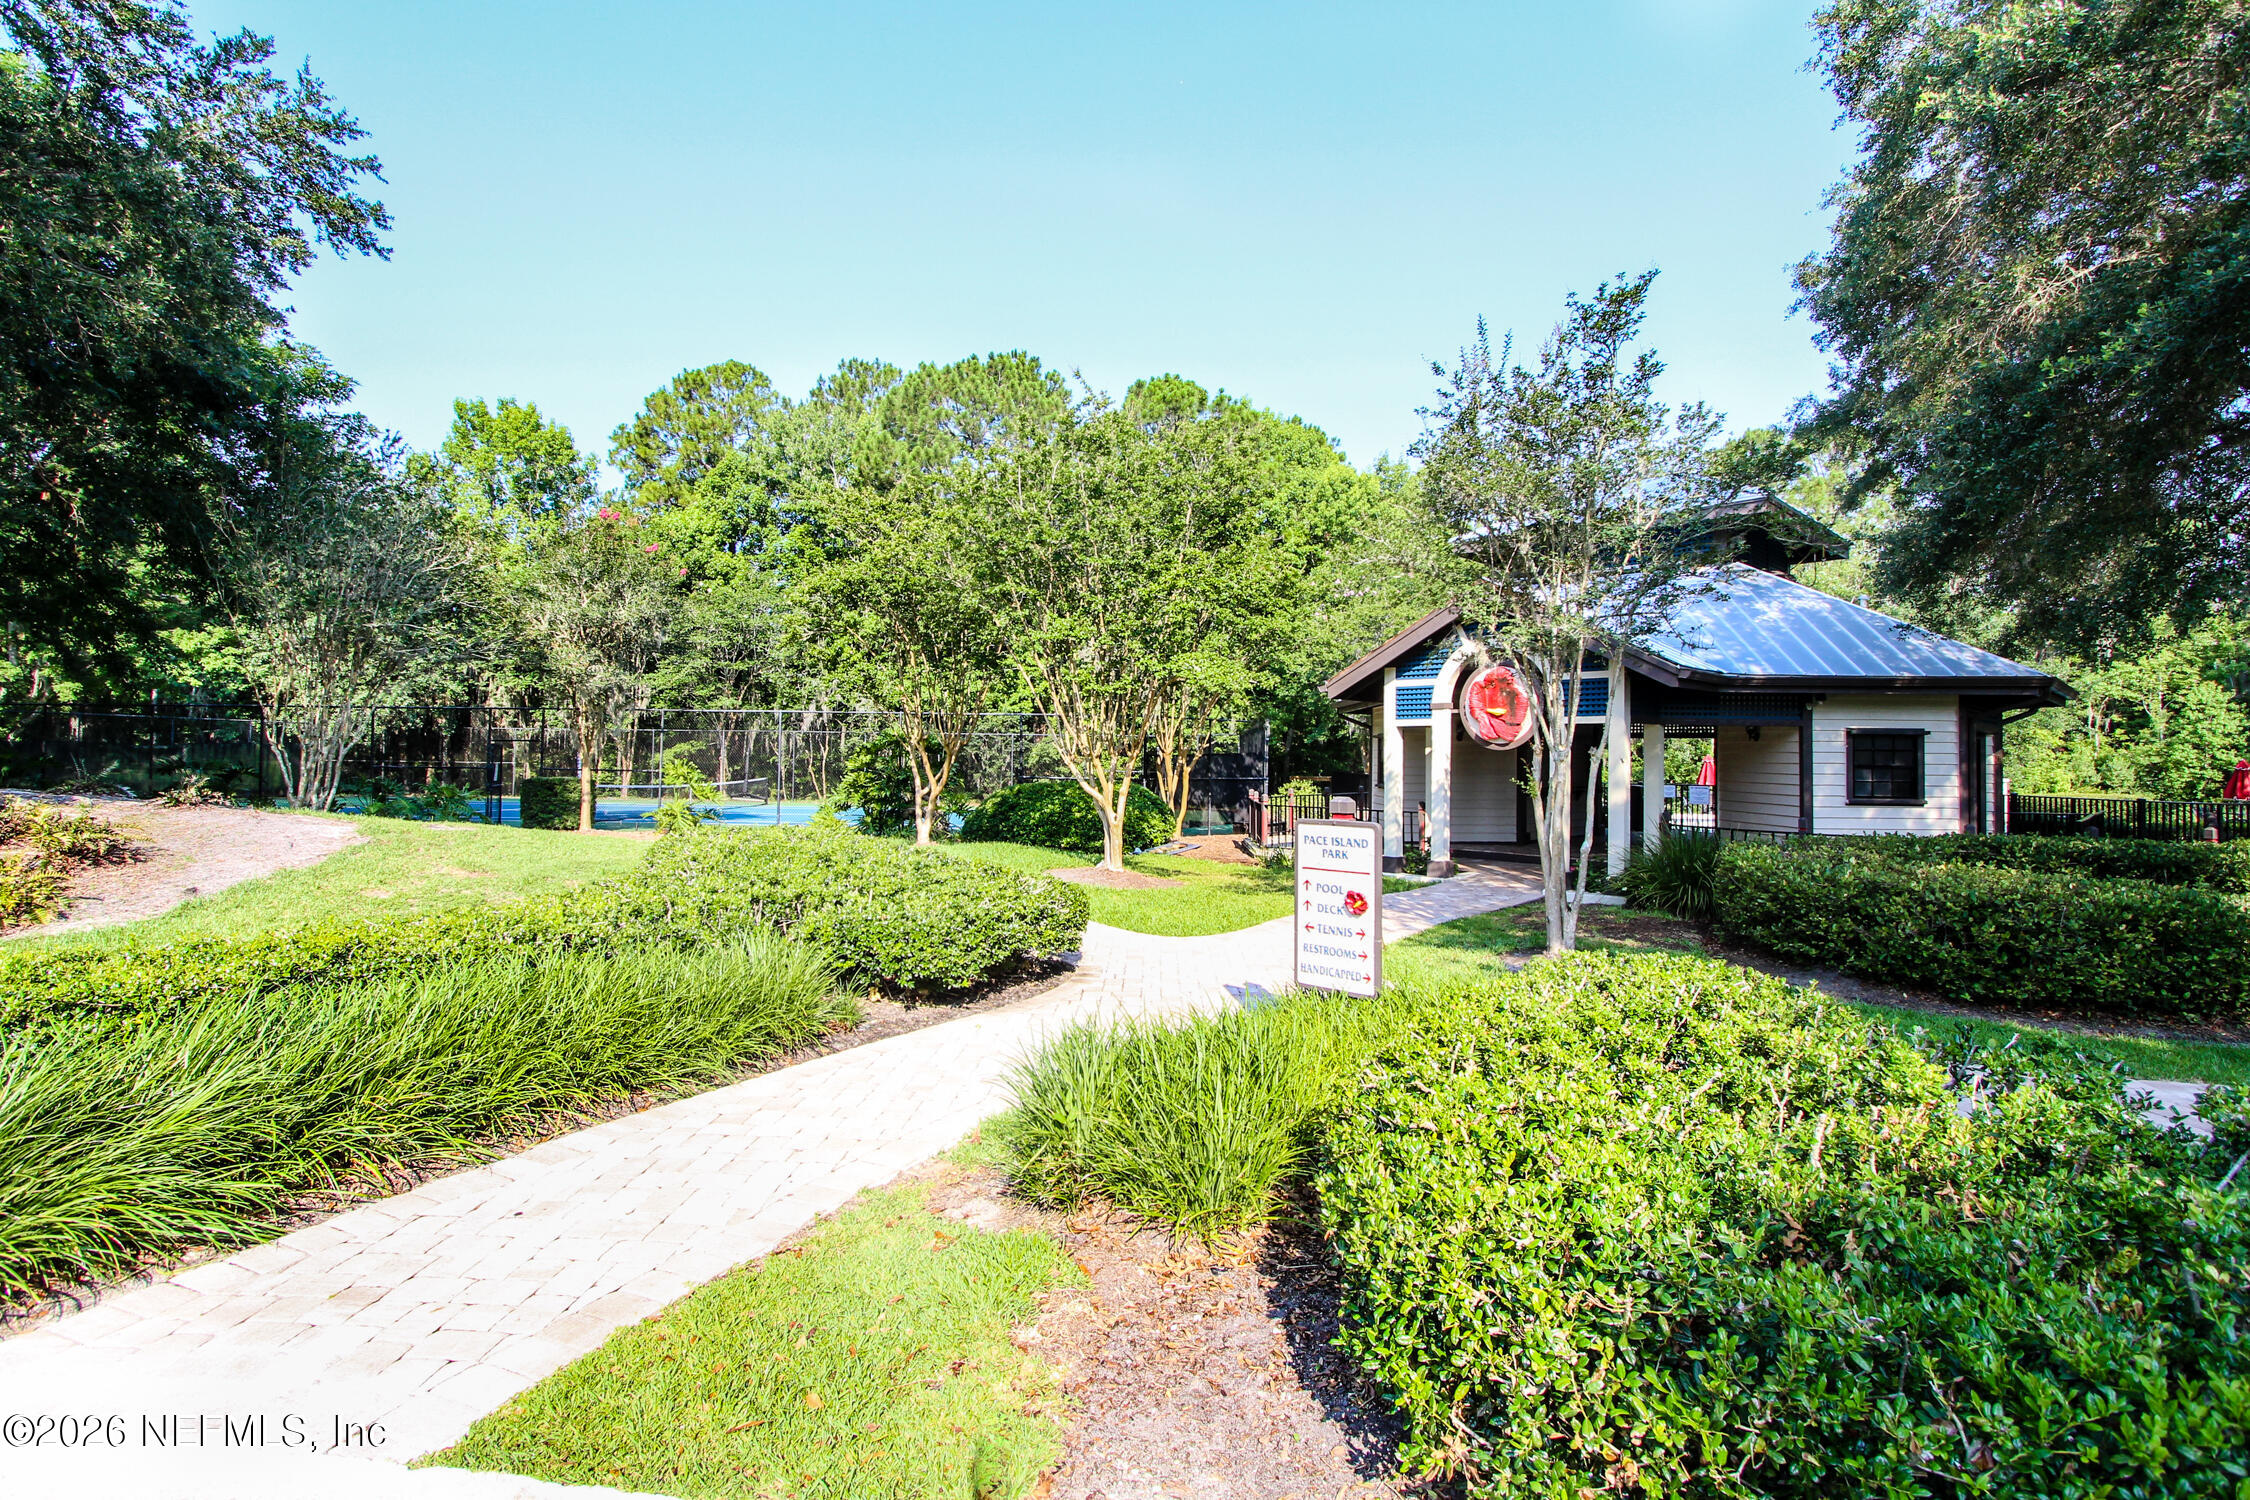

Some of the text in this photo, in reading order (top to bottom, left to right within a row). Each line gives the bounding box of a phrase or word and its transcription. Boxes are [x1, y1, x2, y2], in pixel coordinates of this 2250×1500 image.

[1303, 835, 1368, 849] PACE ISLAND
[1322, 849, 1348, 860] PARK
[1316, 883, 1344, 895] POOL
[1317, 904, 1343, 915] DECK
[1317, 924, 1353, 938] TENNIS
[1303, 943, 1357, 960] RESTROOMS
[1300, 963, 1362, 982] HANDICAPPED
